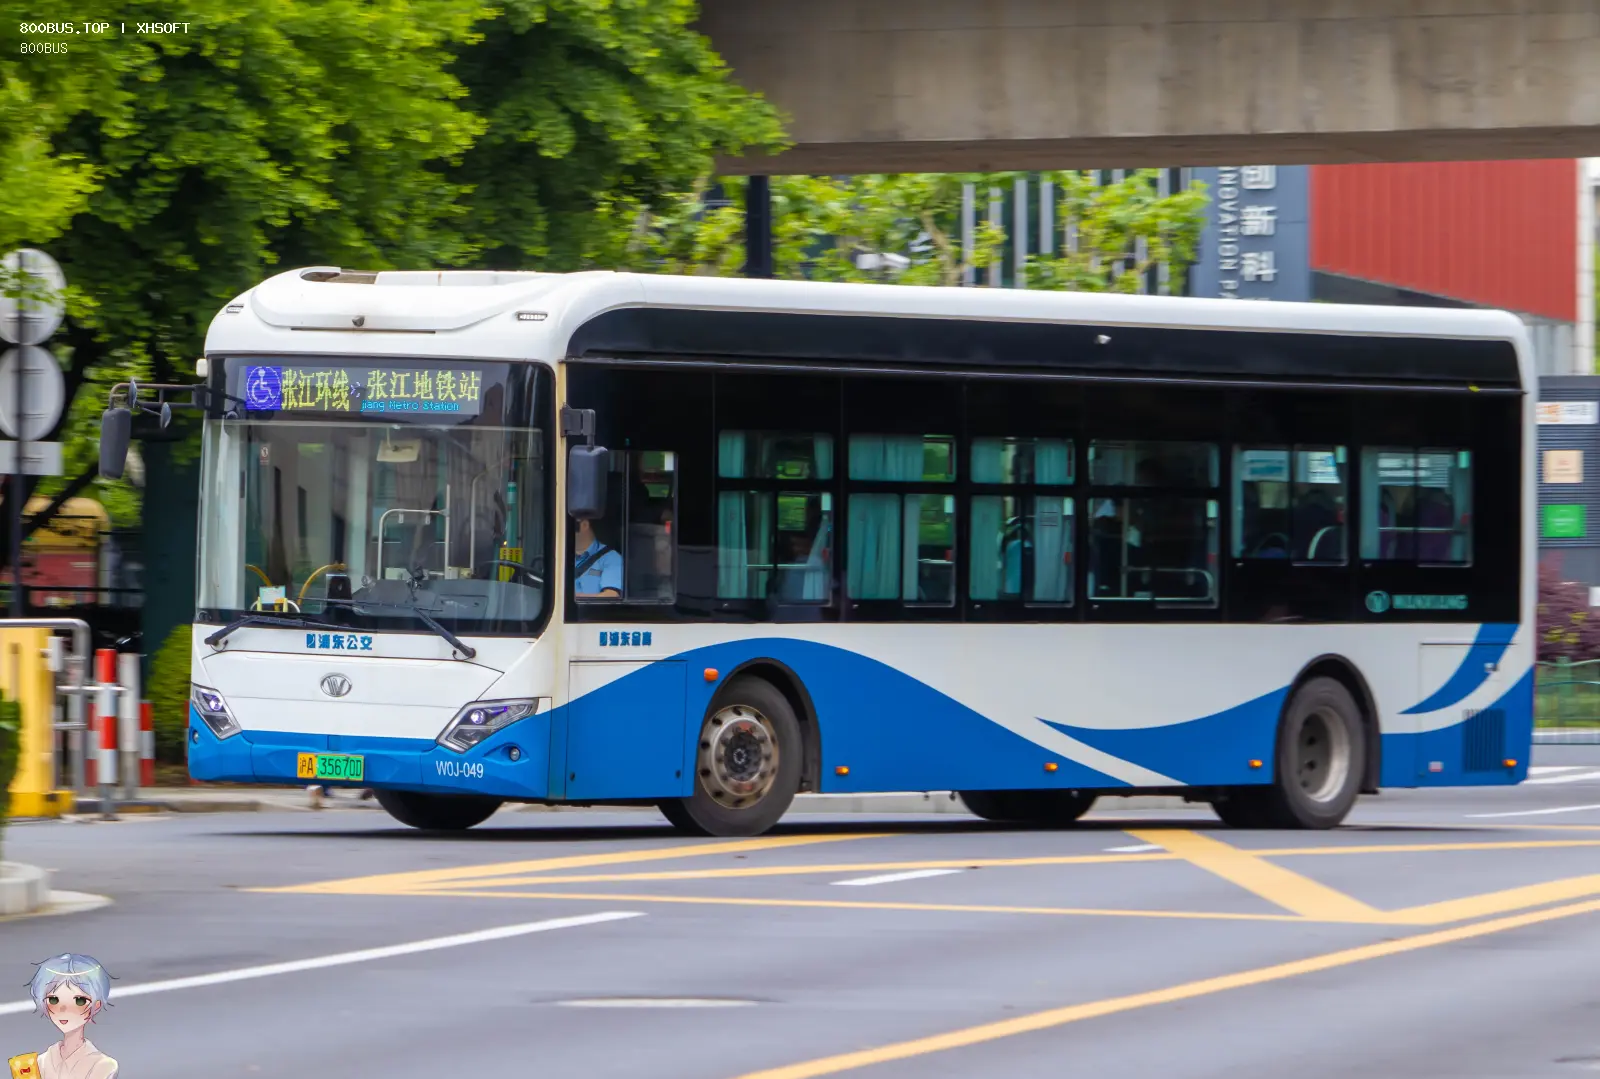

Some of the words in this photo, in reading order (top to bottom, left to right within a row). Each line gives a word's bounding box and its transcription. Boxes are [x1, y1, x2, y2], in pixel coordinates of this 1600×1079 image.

[1240, 165, 1278, 299] 创新科
[367, 370, 481, 401] 张江地铁站
[389, 401, 418, 410] Metro
[423, 401, 459, 411] Station
[318, 633, 373, 650] 浦东公交
